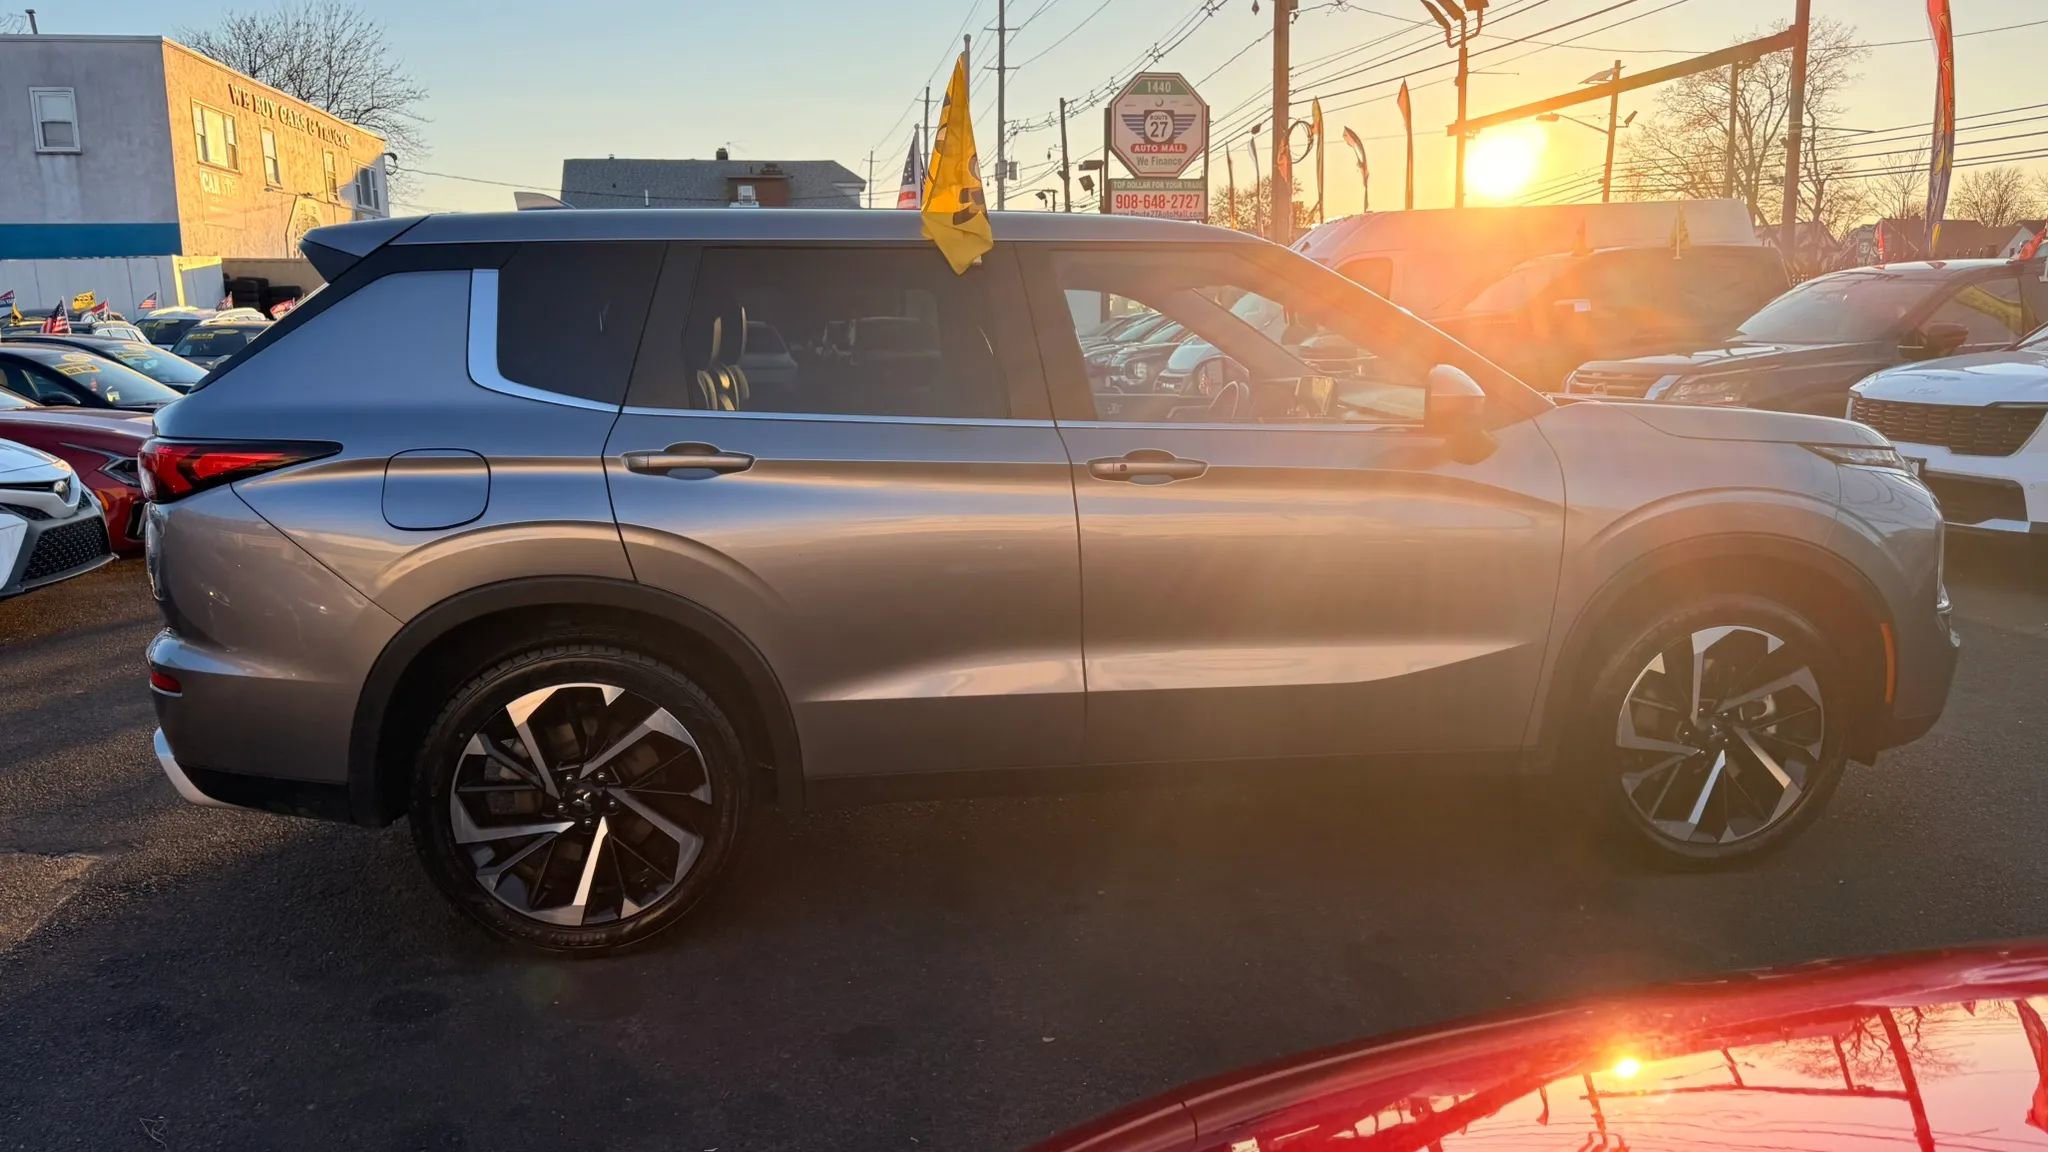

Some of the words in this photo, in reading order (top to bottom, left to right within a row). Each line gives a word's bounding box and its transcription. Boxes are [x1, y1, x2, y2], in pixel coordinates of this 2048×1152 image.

[1147, 81, 1171, 93] 1440
[228, 84, 249, 110] WE
[252, 94, 277, 120] BUY
[278, 105, 305, 132] CARS
[306, 117, 315, 136] &
[315, 121, 352, 150] TRUCKS
[1150, 121, 1168, 138] 27
[1136, 156, 1149, 166] We
[1151, 156, 1183, 166] Finance
[1113, 181, 1125, 189] TOP
[1127, 181, 1151, 189] DOLLAR
[1152, 181, 1164, 189] FOR
[1166, 181, 1182, 189] YOUR
[1116, 194, 1200, 209] 908-648-2727
